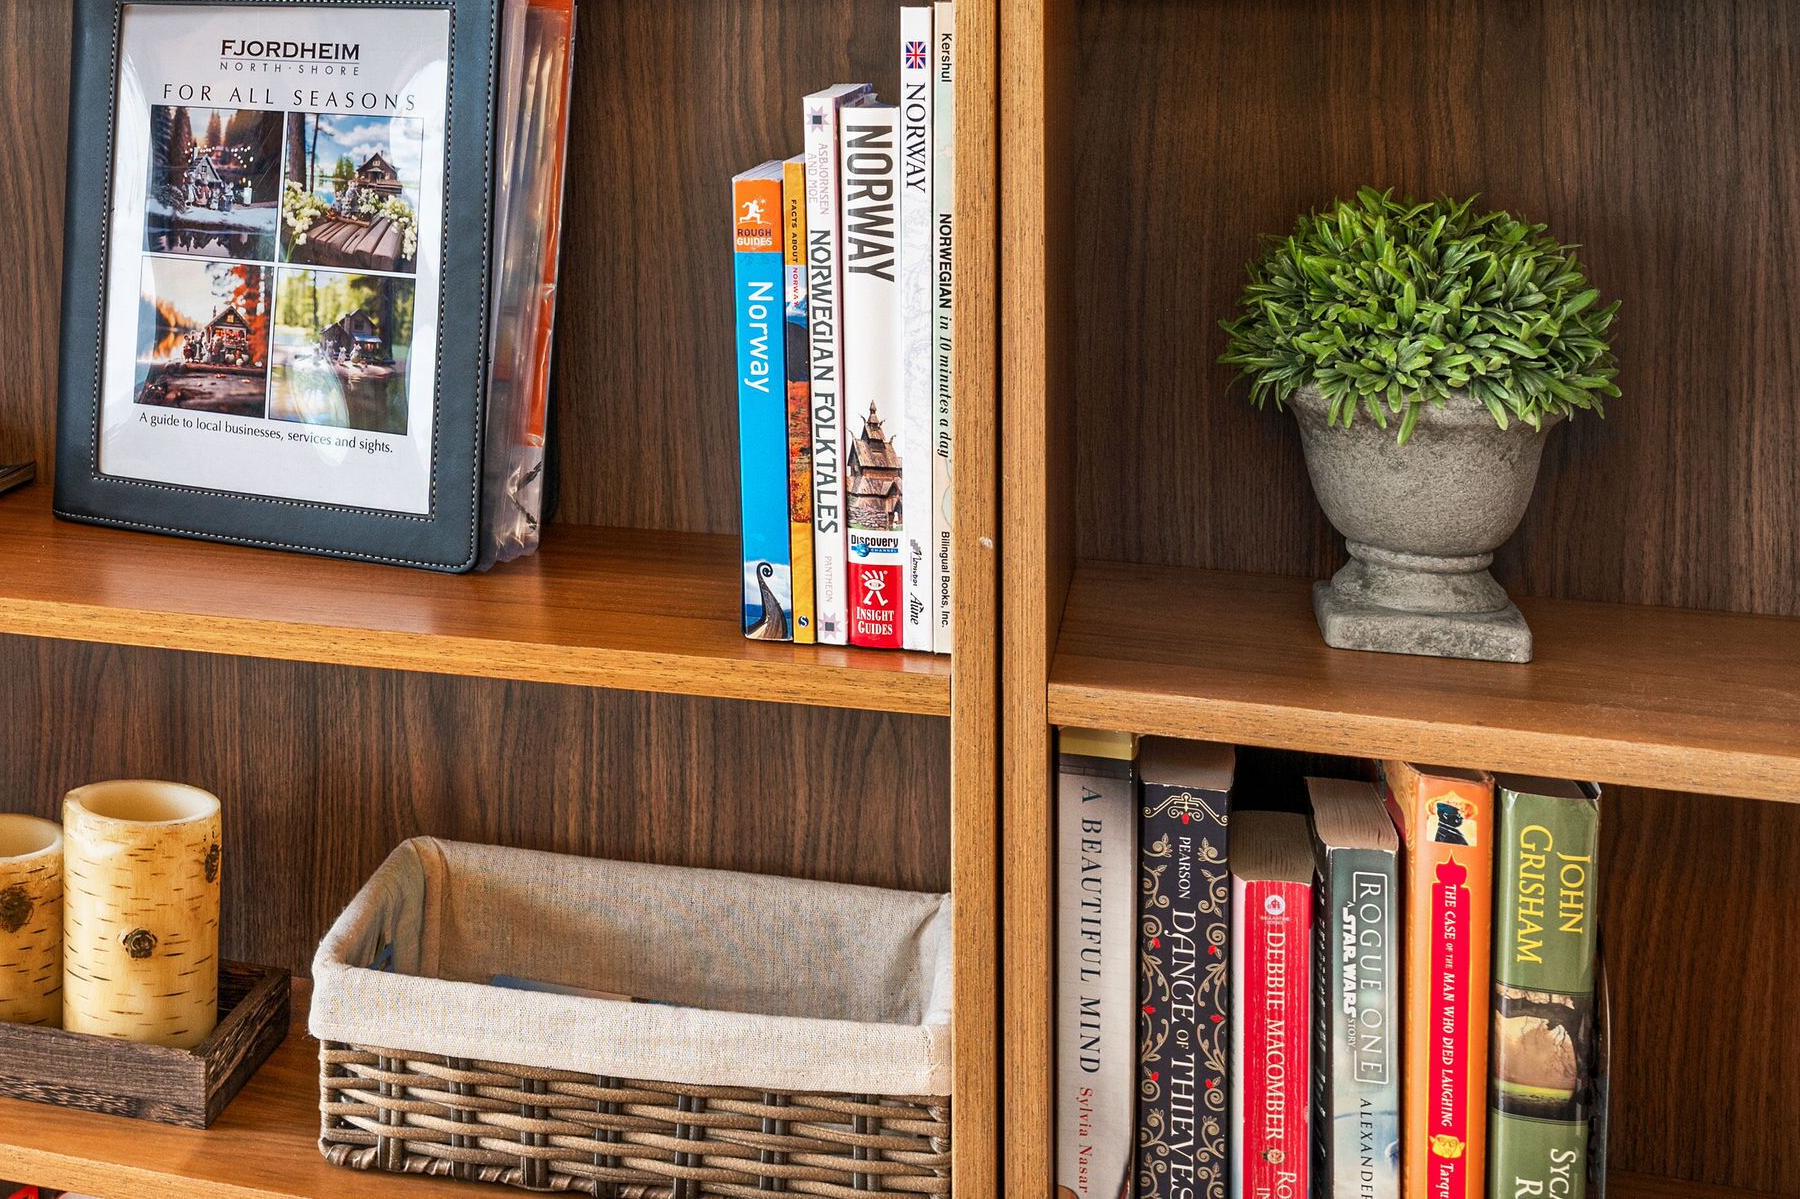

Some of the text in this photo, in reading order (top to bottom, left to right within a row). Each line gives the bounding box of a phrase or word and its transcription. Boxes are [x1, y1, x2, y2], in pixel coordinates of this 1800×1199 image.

[220, 40, 360, 60] FJORDHEIM
[941, 33, 952, 83] Kershul
[162, 84, 416, 111] FOR ALL SEASONS
[906, 83, 926, 194] NORWAY
[737, 229, 772, 237] ROUGH
[846, 125, 895, 282] NORWAY
[737, 237, 773, 246] GUIDES
[745, 281, 774, 393] Norway
[810, 228, 839, 534] NORWEGIAN FOLKTALES
[139, 412, 393, 454] A guide to local businesses, services and sights.
[851, 535, 899, 547] Discovery
[856, 608, 895, 622] INSIGHT
[858, 622, 893, 635] GUIDES
[1516, 824, 1554, 964] GRISHAM
[1556, 852, 1591, 935] JOHN
[1079, 785, 1101, 1075] A BEAUTIFUL MIND
[1359, 881, 1383, 1076] ROGUE ONE
[1265, 930, 1287, 1142] DEBBIE MACOMBER
